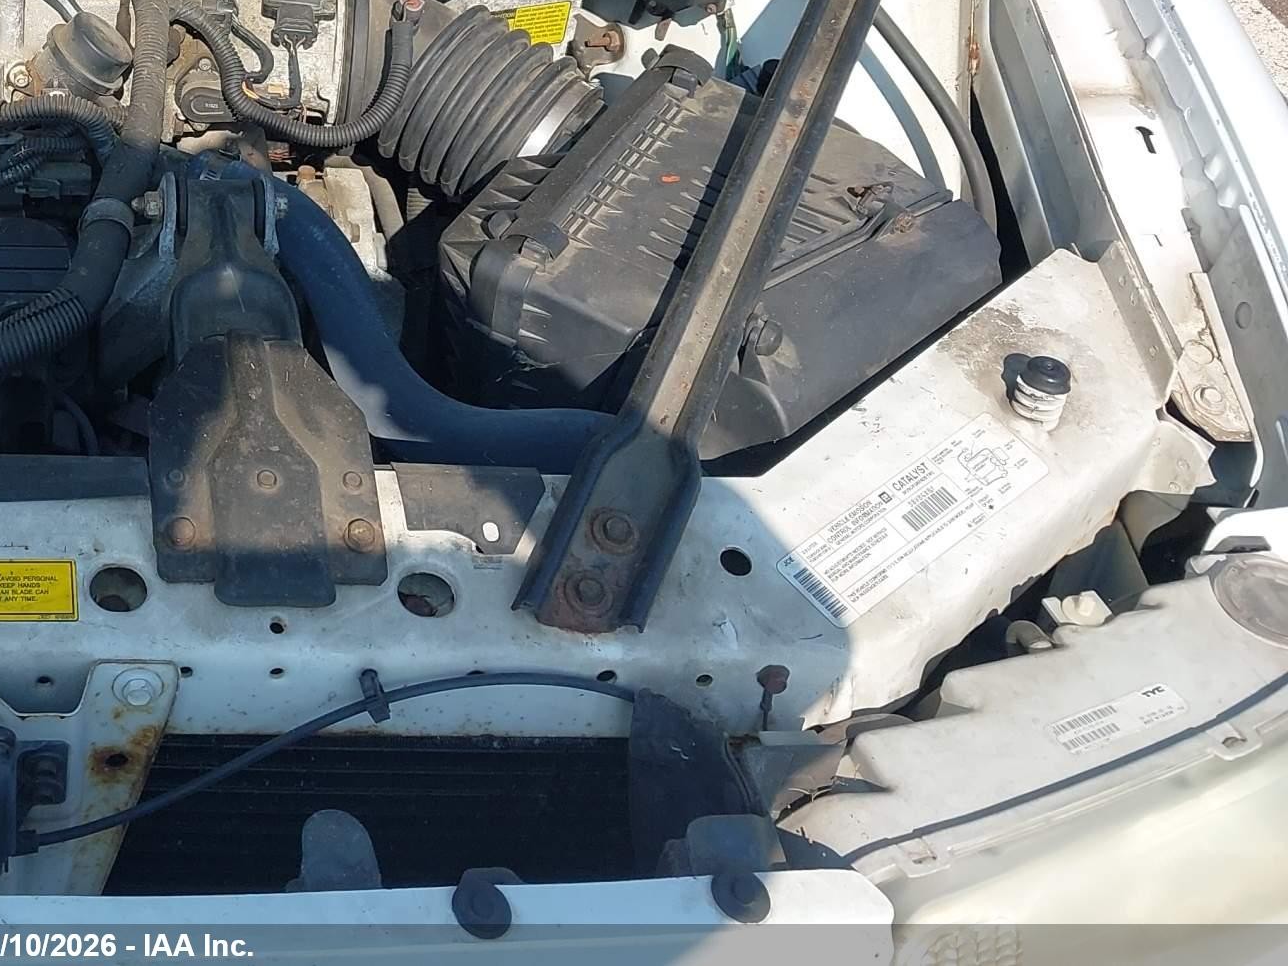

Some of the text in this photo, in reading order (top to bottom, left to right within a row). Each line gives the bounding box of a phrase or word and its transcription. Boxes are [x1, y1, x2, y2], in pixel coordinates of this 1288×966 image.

[891, 462, 931, 492] CATALYST
[827, 501, 885, 544] CONTROL INFORMATION
